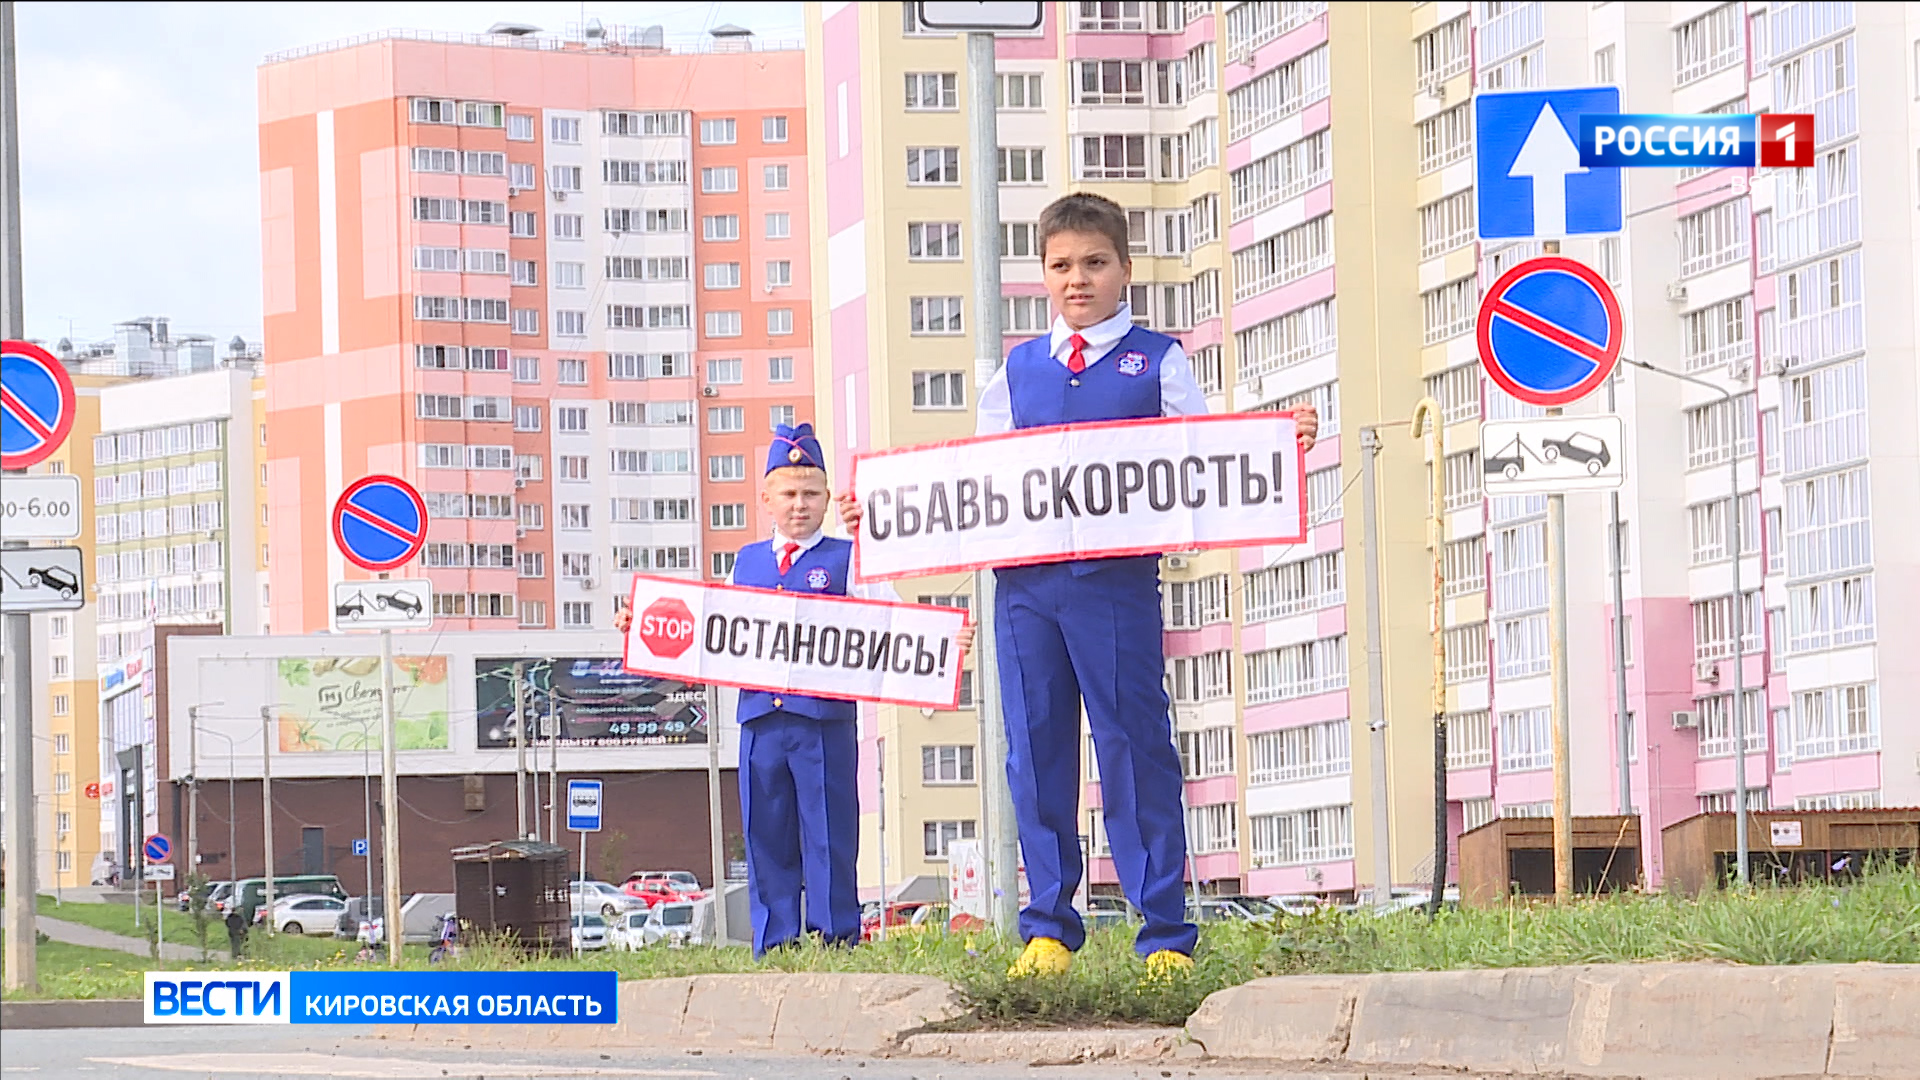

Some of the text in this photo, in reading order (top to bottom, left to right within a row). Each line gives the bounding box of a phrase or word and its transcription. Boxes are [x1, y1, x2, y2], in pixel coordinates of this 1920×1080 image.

[866, 451, 1284, 542] СБАВЬ СКОРОСТЬ!
[641, 615, 693, 641] STOP
[705, 613, 949, 678] ОСТАНОВИСЬ!
[609, 721, 685, 735] 49-99-49
[356, 841, 366, 854] P
